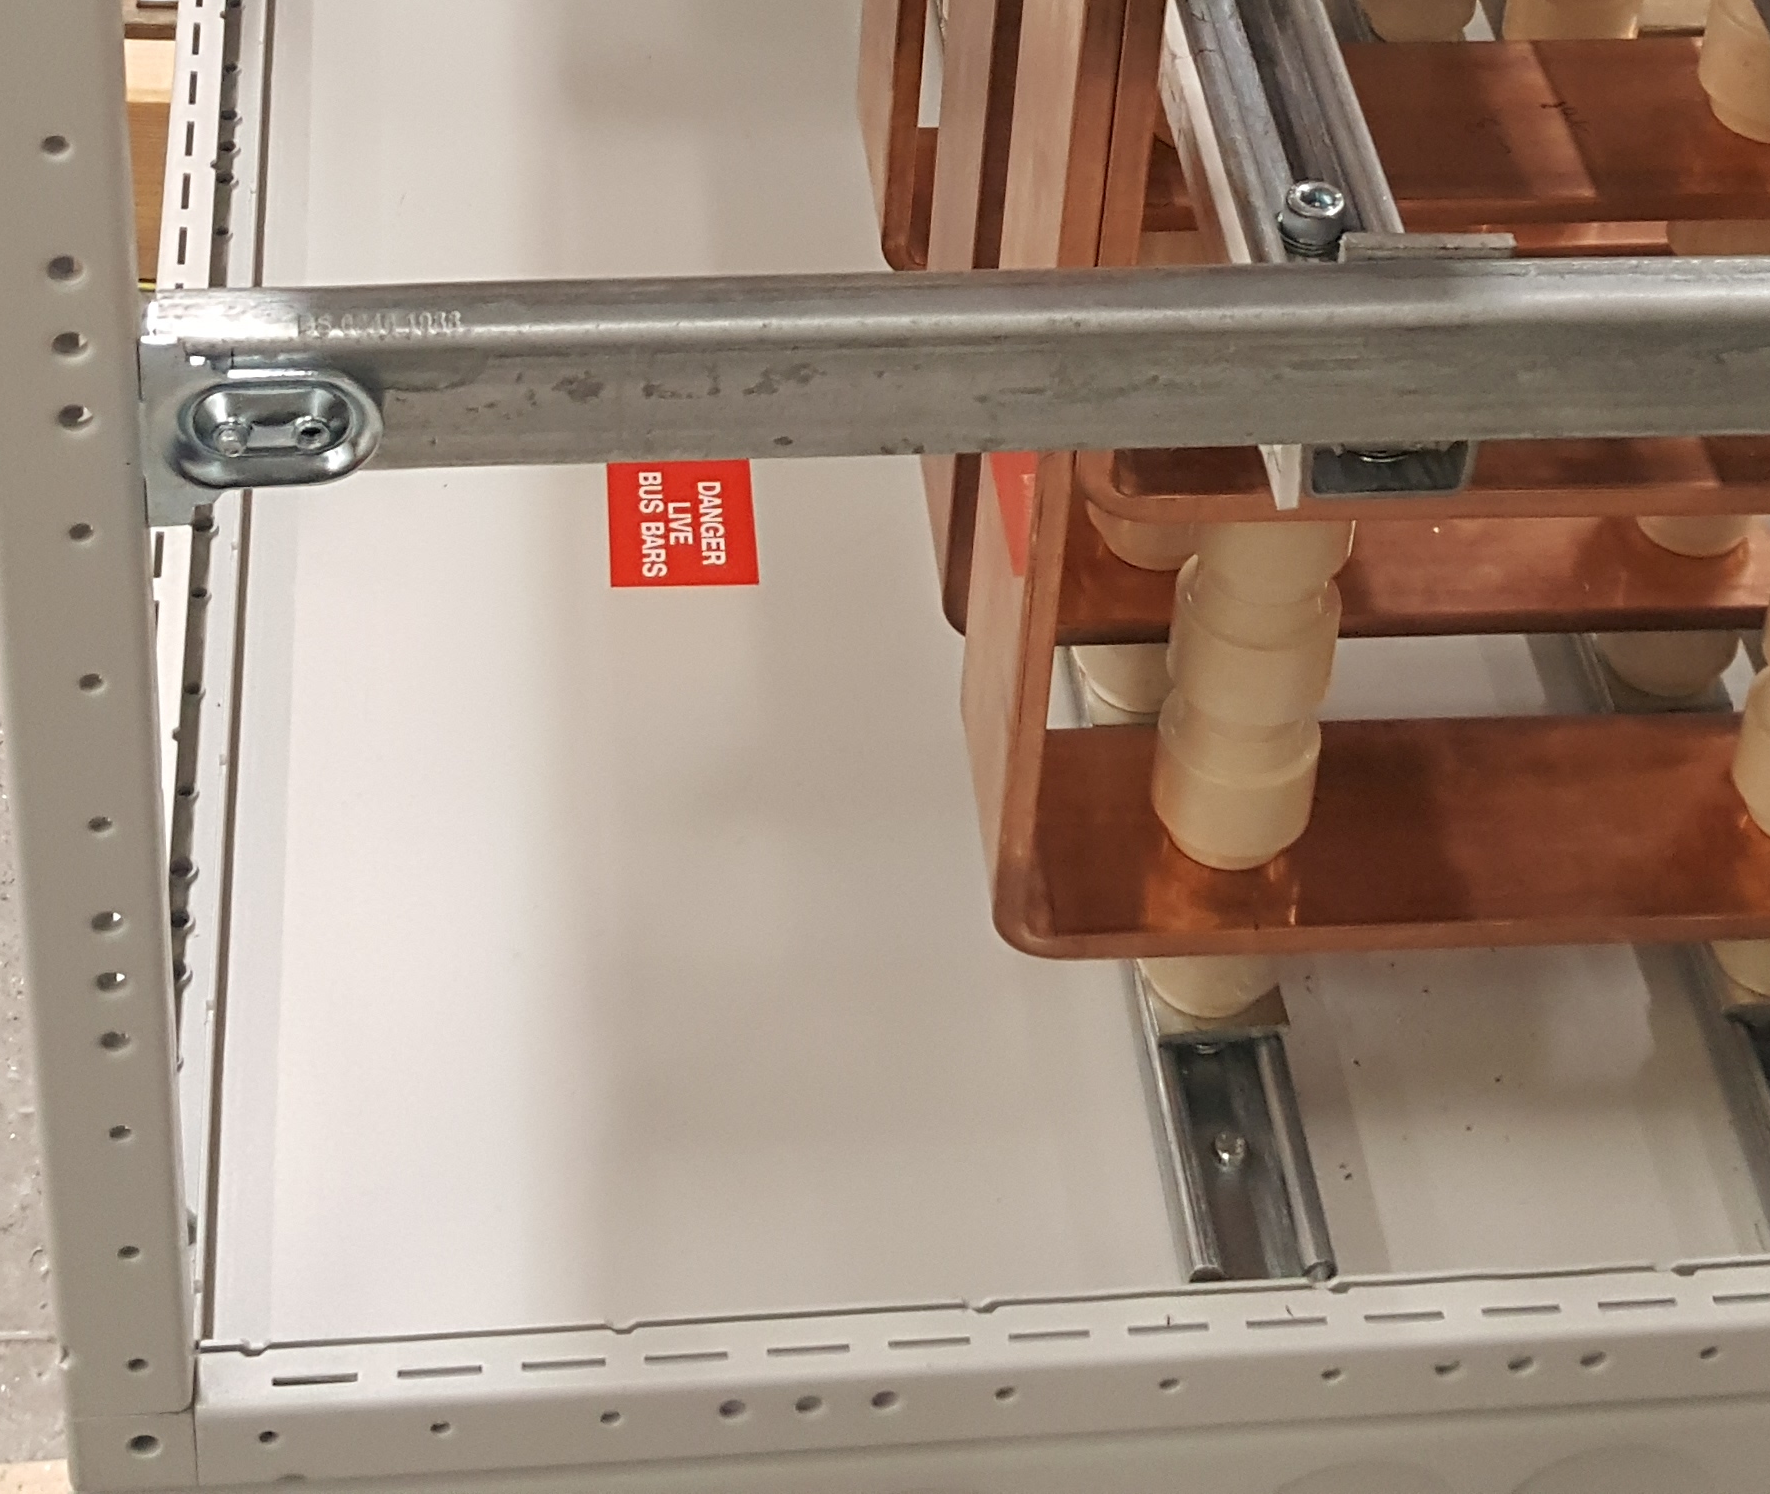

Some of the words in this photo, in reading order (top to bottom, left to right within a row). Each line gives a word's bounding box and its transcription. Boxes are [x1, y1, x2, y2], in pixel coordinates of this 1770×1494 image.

[638, 472, 665, 514] BUS
[668, 502, 693, 546] LIVE
[697, 481, 726, 566] DANGER
[641, 522, 668, 578] BARS
